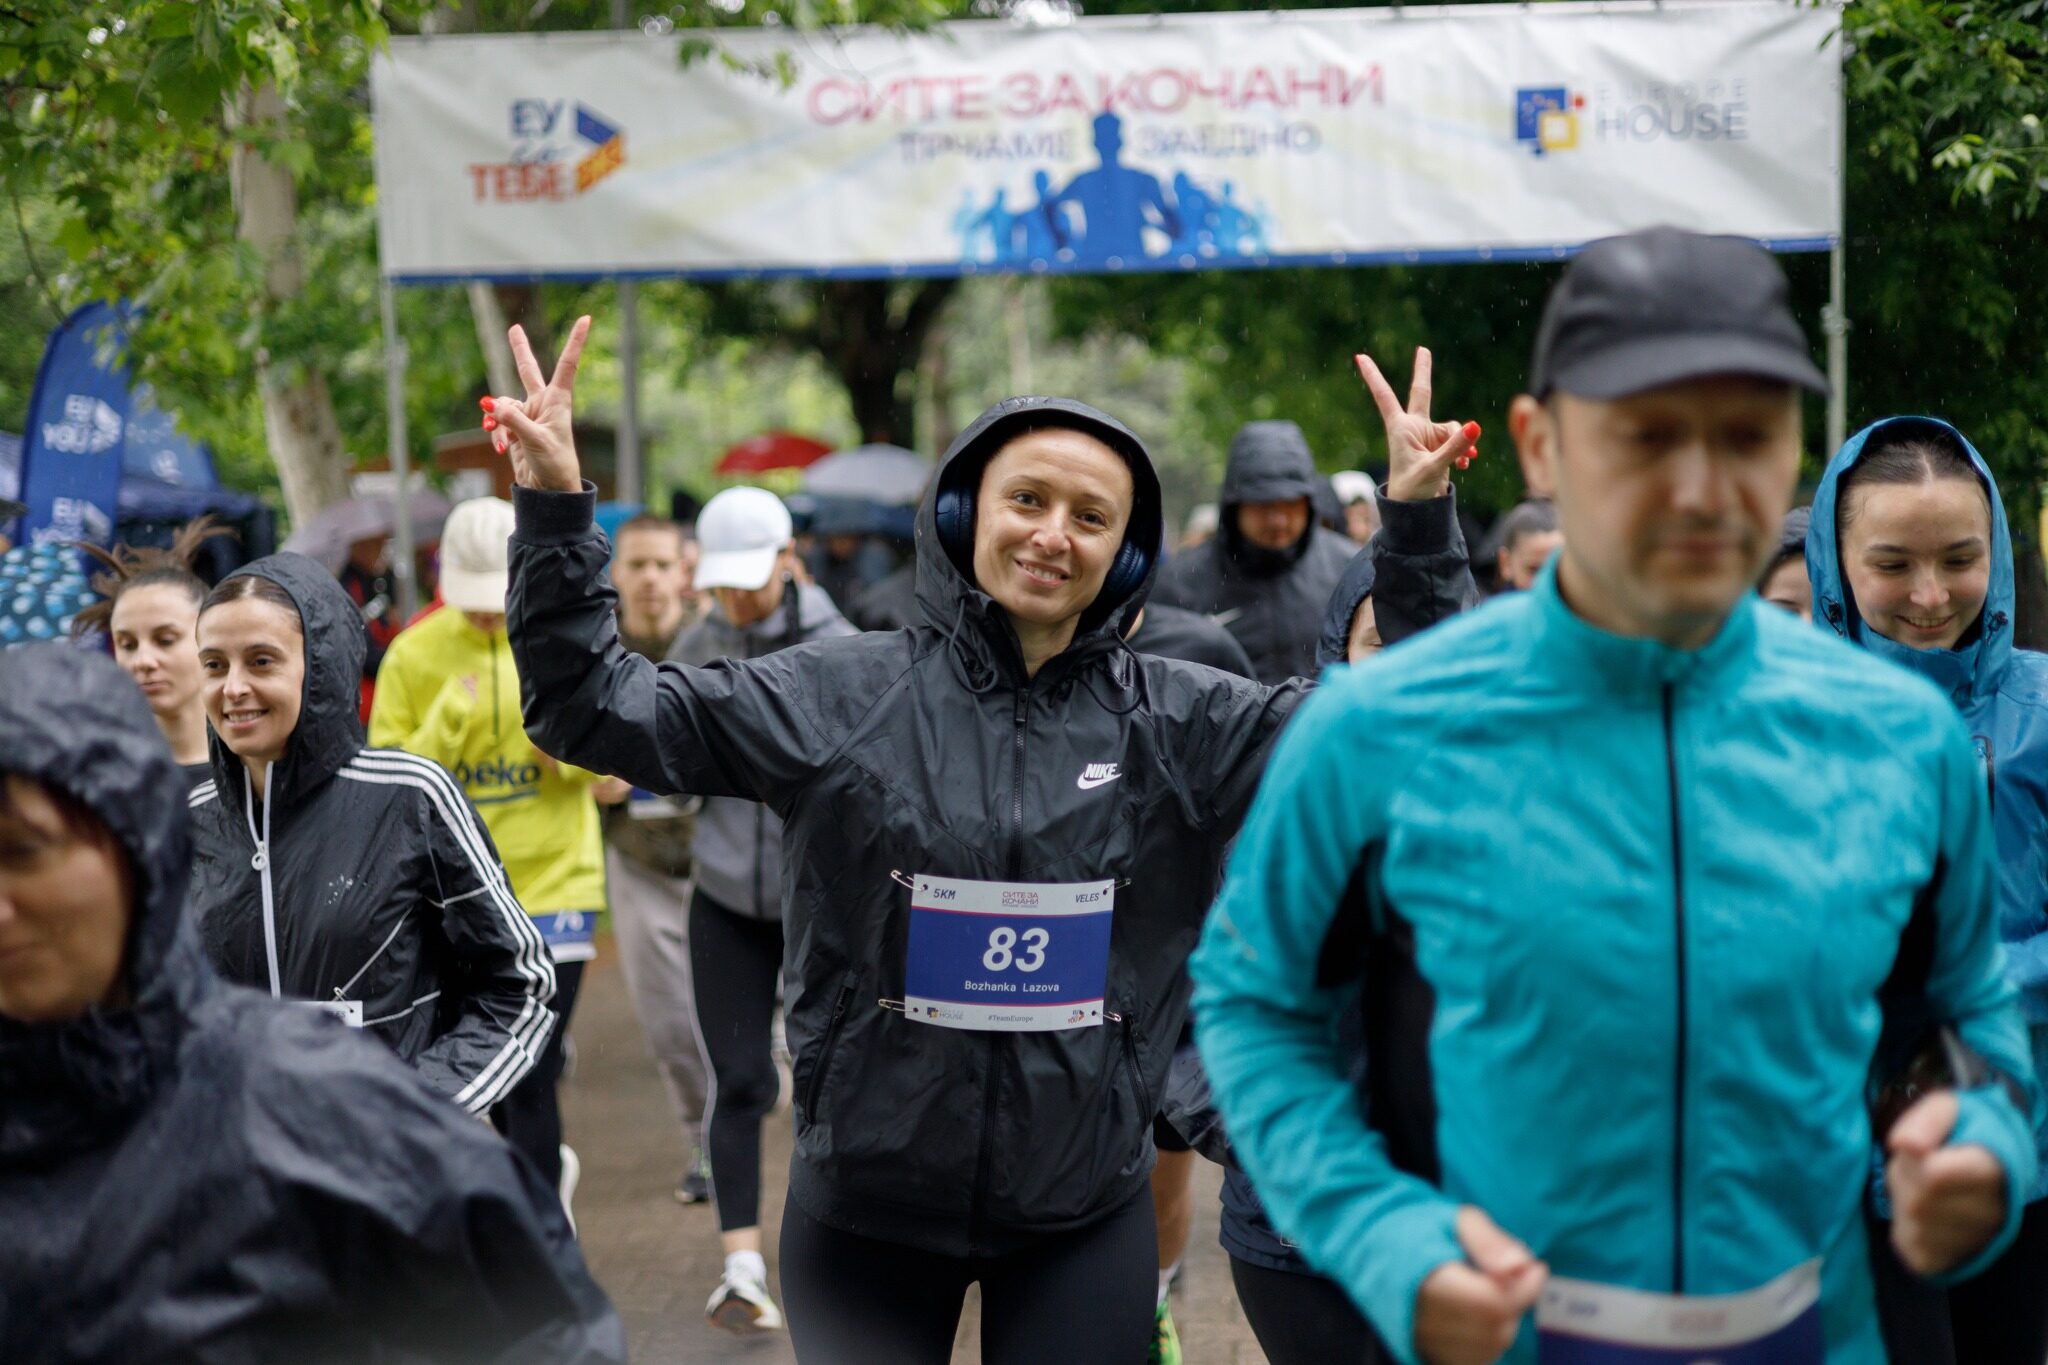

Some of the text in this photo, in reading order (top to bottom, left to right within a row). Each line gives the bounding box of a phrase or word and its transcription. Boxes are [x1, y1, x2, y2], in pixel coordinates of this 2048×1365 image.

[808, 64, 1384, 125] СИТЕ ЗА КОЧАНИ
[1597, 102, 1748, 142] HOUSE
[457, 755, 541, 786] beko
[1084, 763, 1117, 778] NIKE
[933, 888, 956, 900] 5KM
[1075, 893, 1100, 903] VELES
[982, 926, 1050, 972] 83
[964, 980, 1060, 993] Bozhanka Lazova
[988, 1014, 1034, 1023] #TeamEurope
